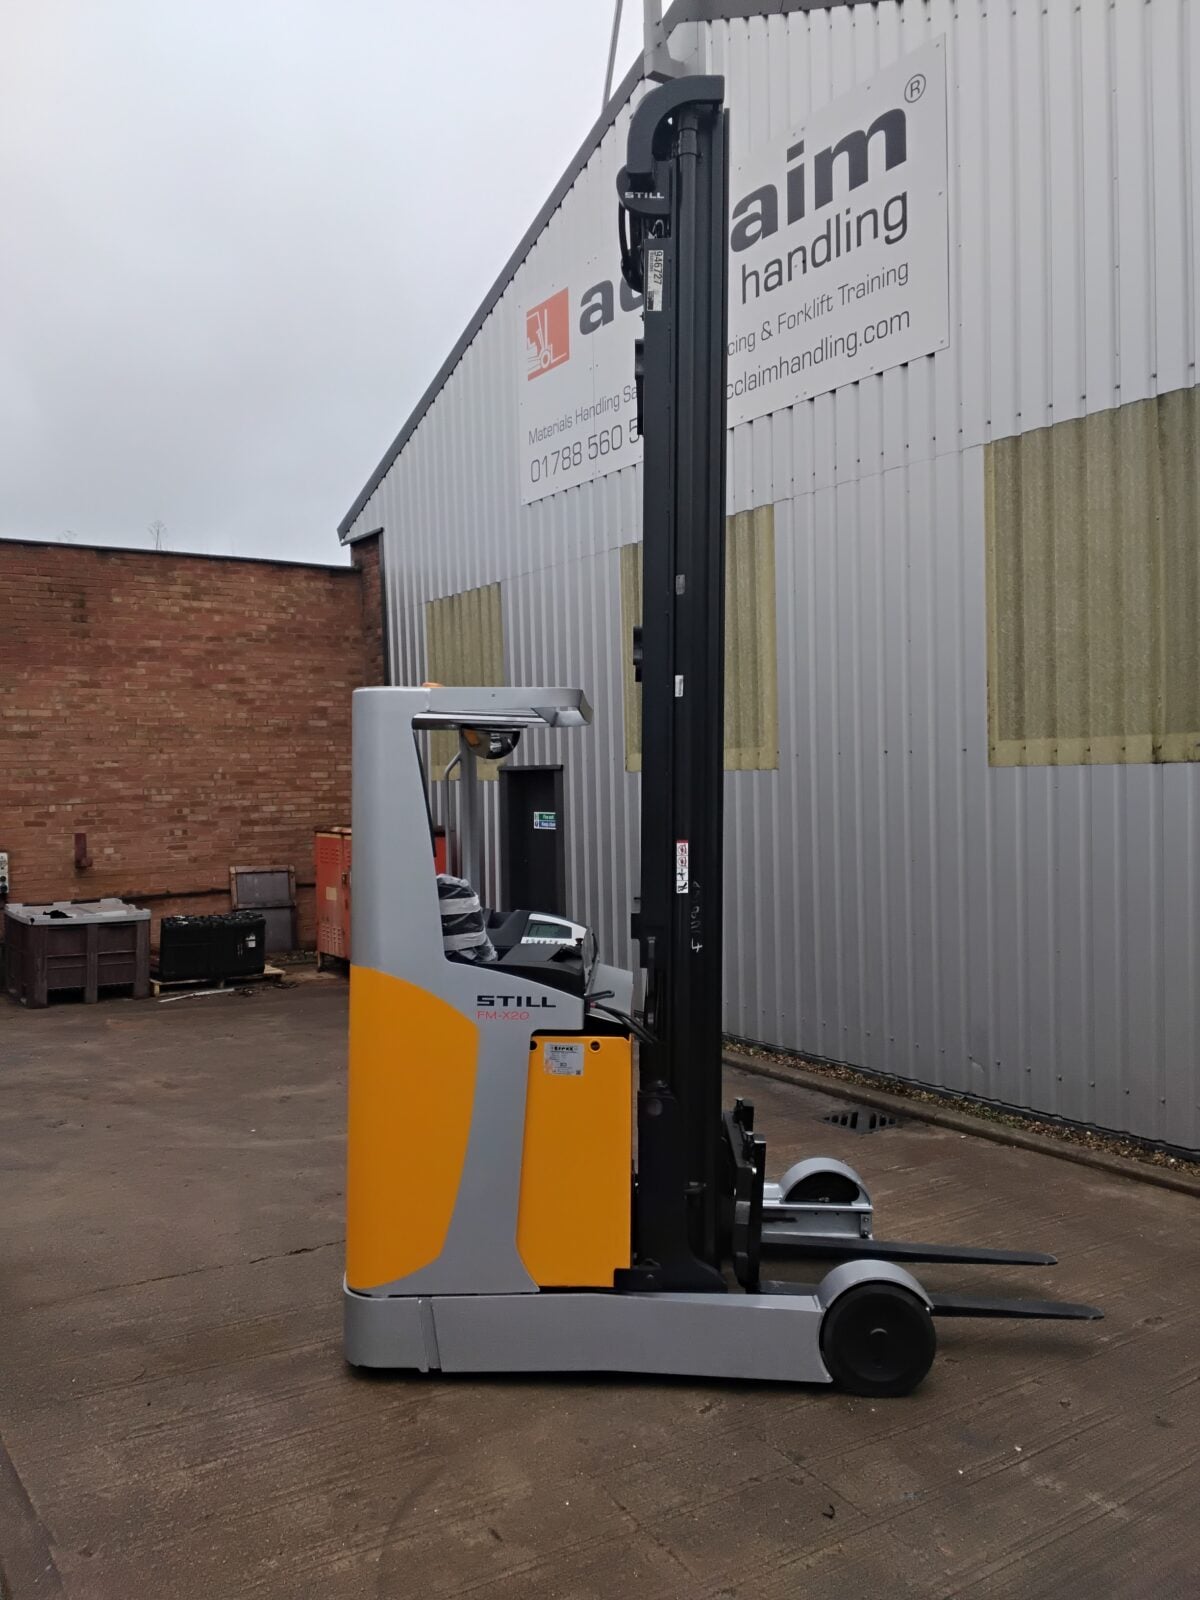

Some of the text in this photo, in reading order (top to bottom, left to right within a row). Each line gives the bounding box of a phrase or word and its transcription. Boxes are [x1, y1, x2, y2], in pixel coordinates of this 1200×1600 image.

[624, 191, 665, 199] STILL
[741, 191, 907, 305] handling
[528, 414, 573, 446] Materials
[575, 394, 620, 425] Handling
[760, 320, 773, 341] &
[778, 294, 834, 335] Forklift
[838, 262, 909, 306] Training
[530, 441, 582, 483] 01788
[588, 424, 623, 460] 560
[476, 995, 557, 1008] STILL
[476, 1010, 530, 1021] FM-X20
